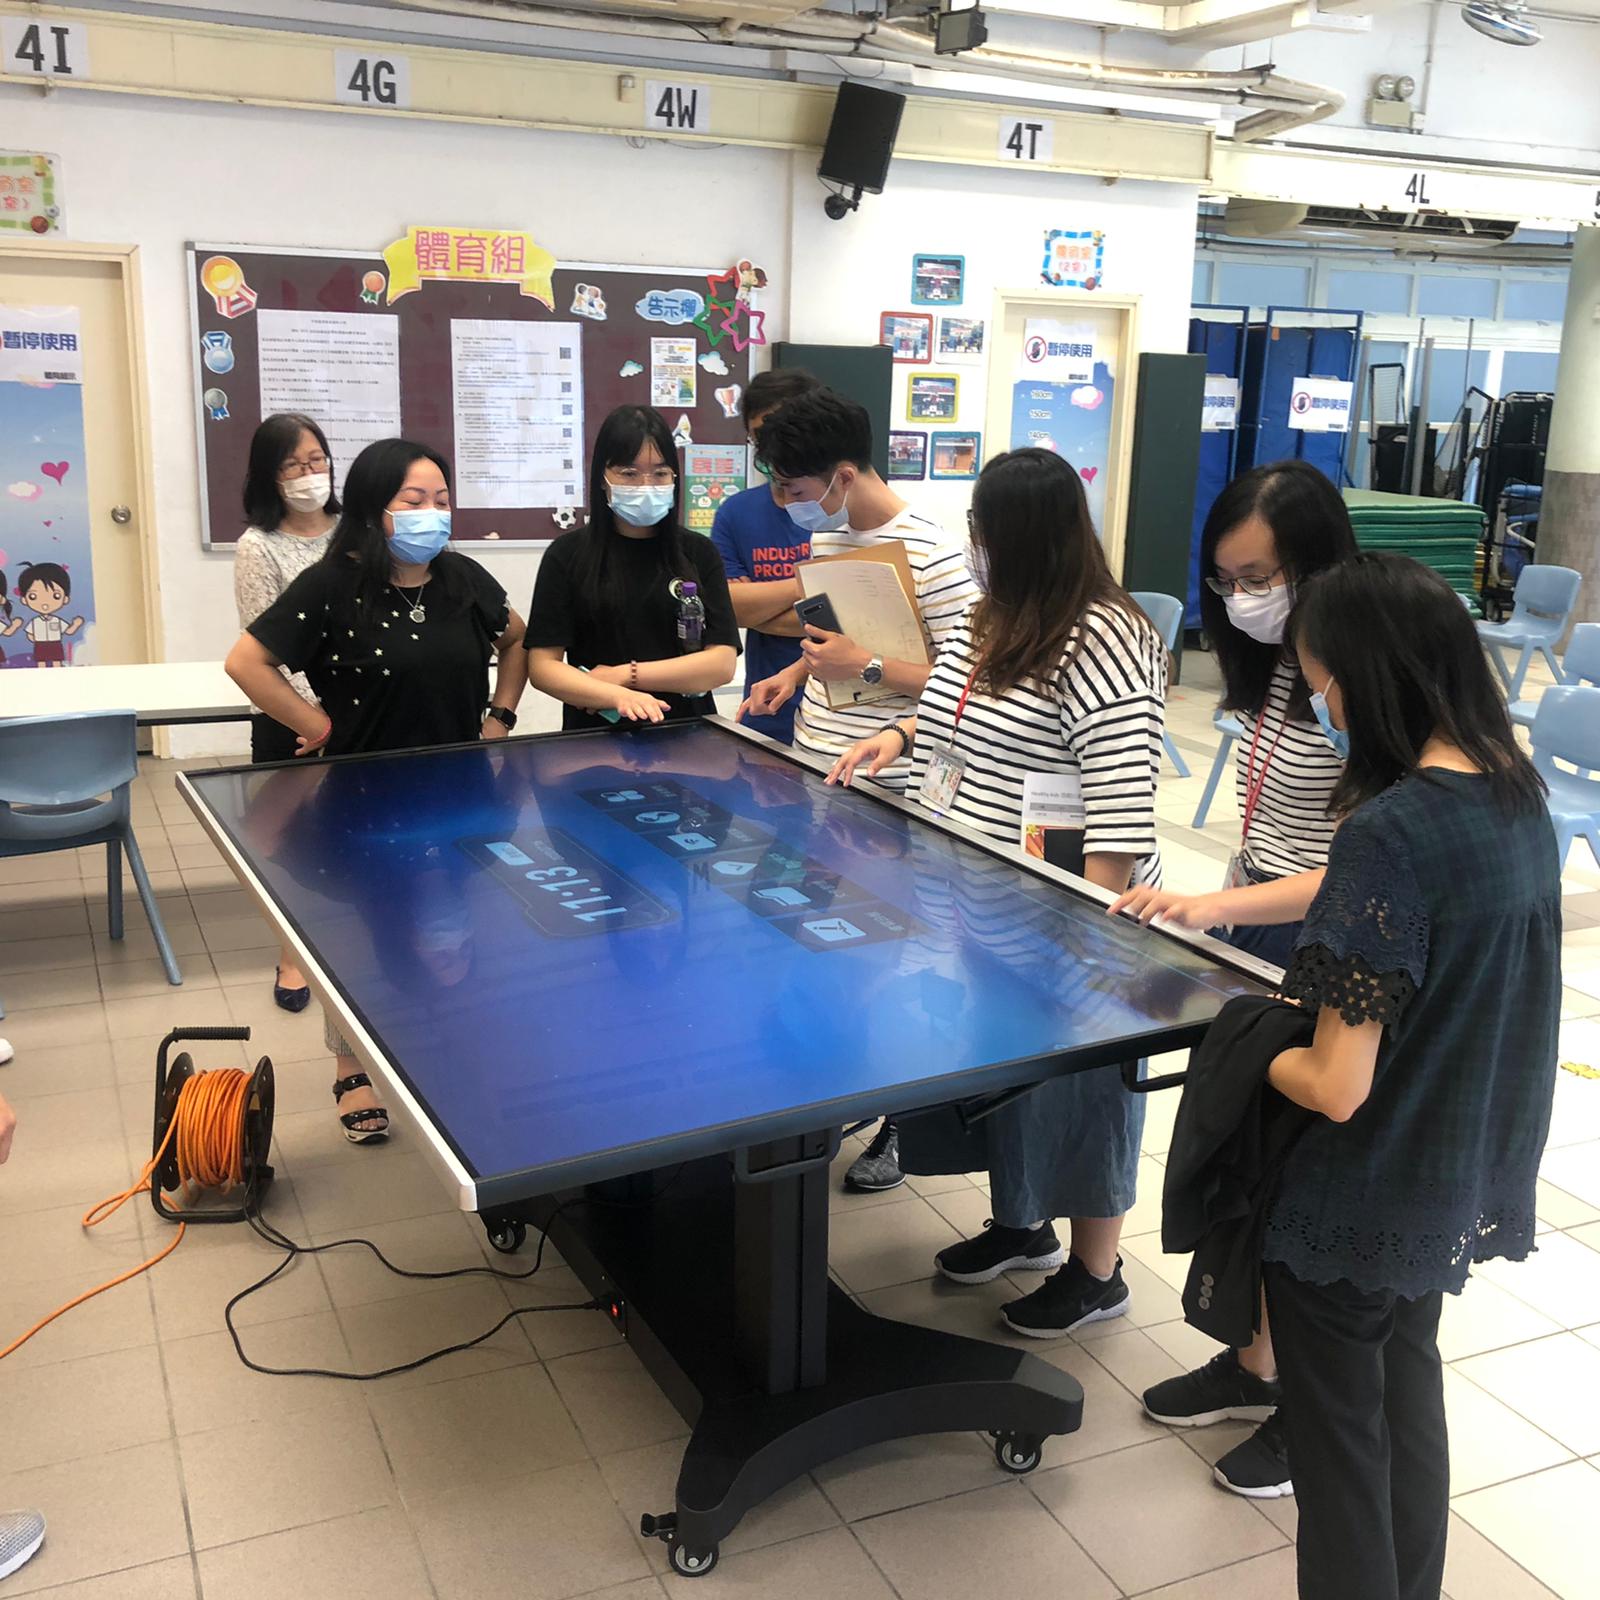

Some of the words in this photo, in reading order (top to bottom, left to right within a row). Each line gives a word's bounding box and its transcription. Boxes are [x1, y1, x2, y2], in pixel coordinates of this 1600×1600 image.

[347, 59, 397, 104] 4G
[655, 87, 697, 128] 4W
[1006, 122, 1043, 160] 4T
[1405, 173, 1430, 204] 4L
[415, 230, 525, 275] 體育組
[2, 330, 78, 352] 暫停使用
[1047, 341, 1093, 358] 暫停使用
[525, 866, 628, 922] 11:13
